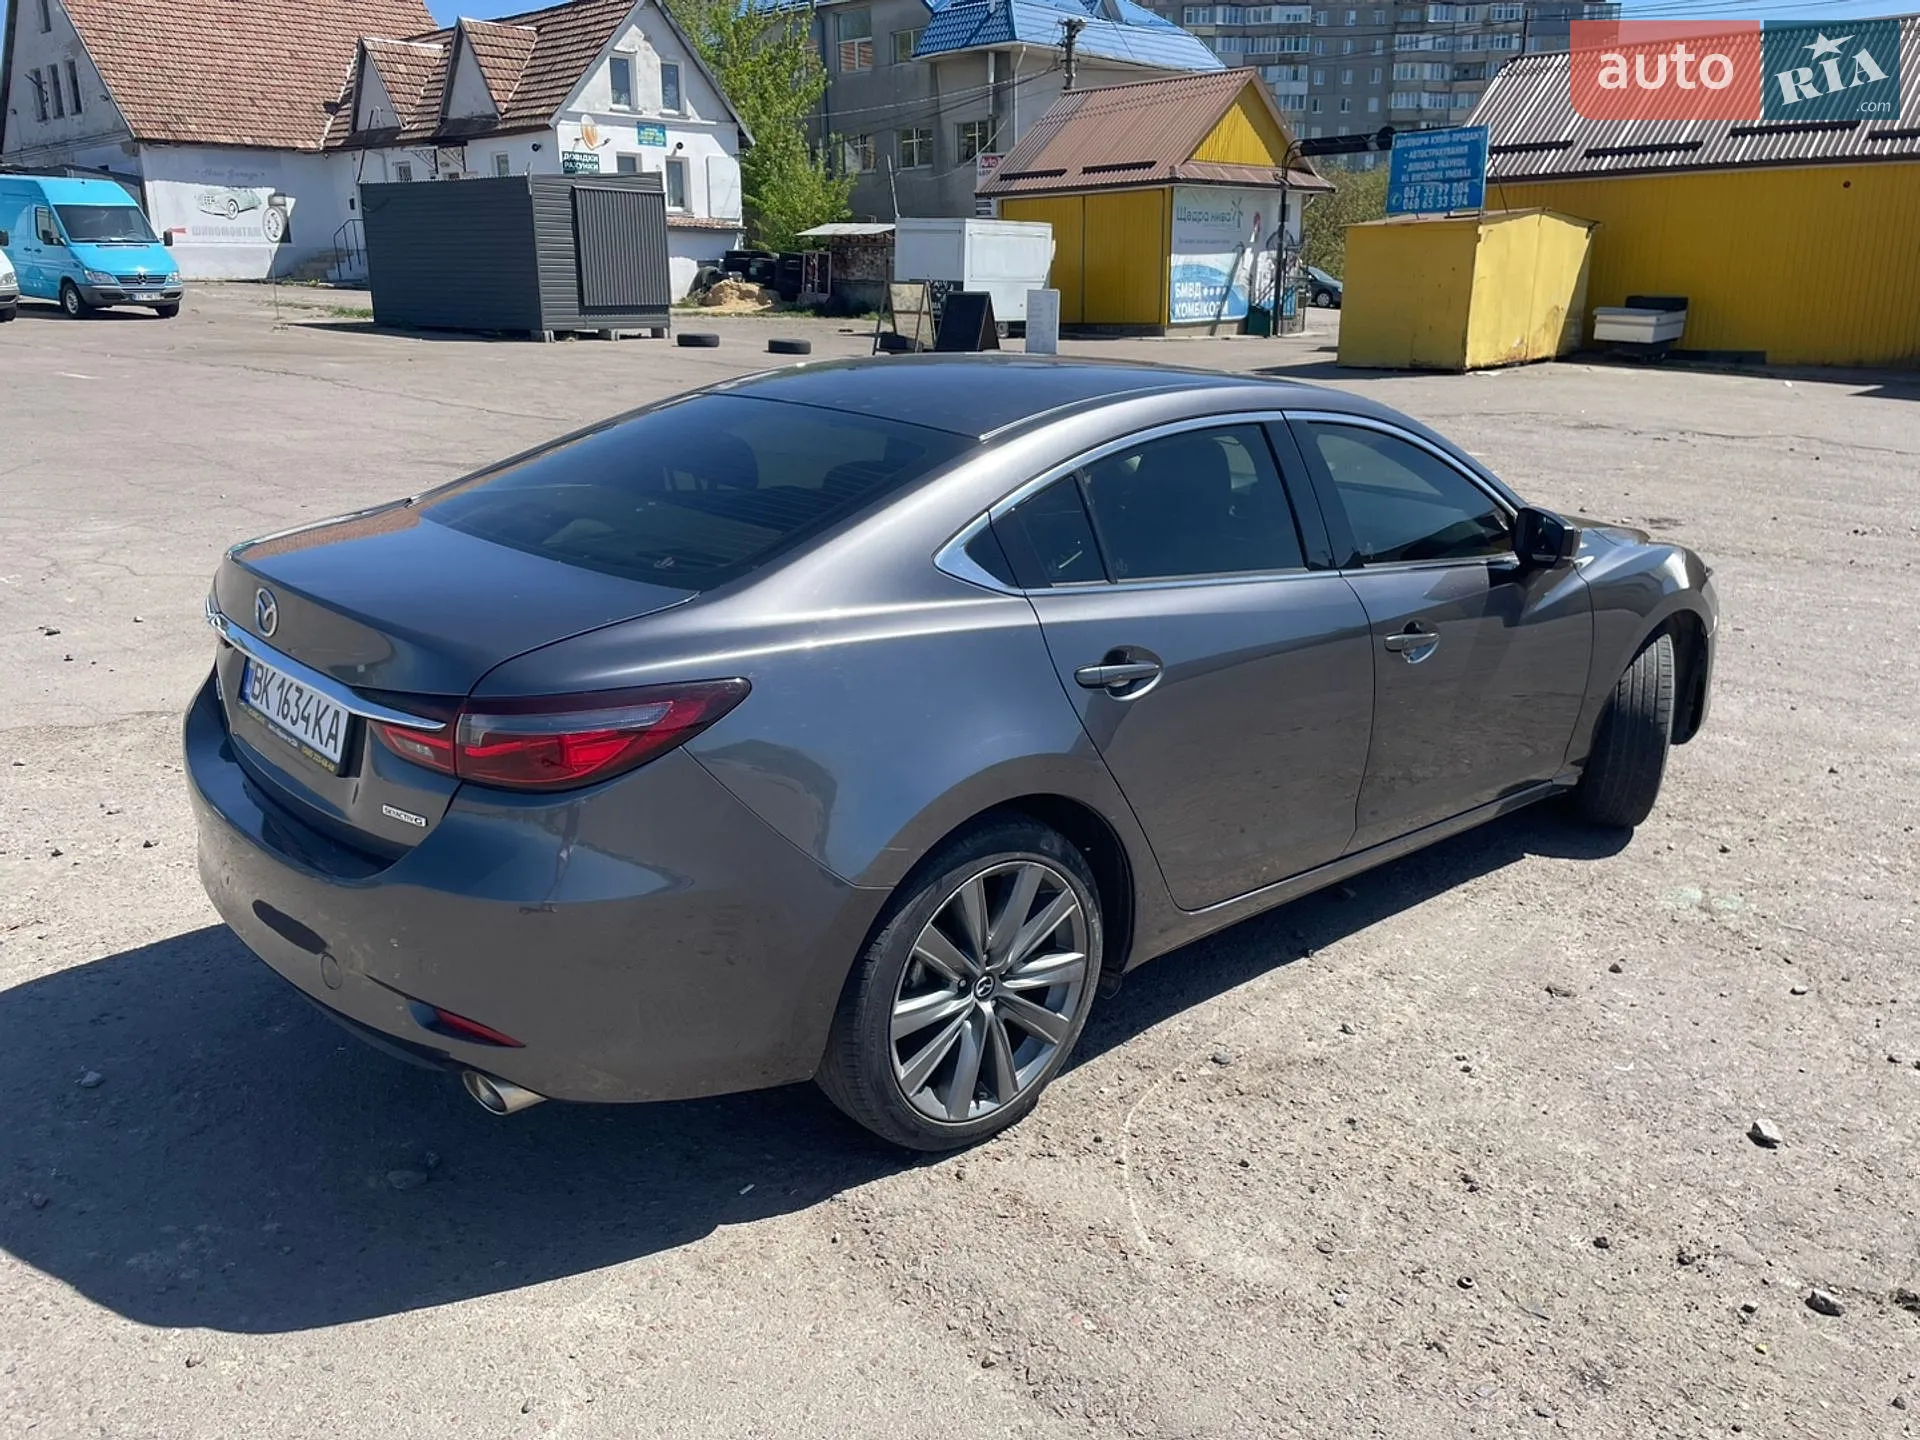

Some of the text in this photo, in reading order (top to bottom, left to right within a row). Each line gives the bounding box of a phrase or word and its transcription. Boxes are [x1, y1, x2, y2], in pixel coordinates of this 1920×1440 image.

[563, 153, 598, 162] ДОВІДКИ
[1176, 206, 1209, 225] Щедра
[1174, 282, 1201, 299] БМВД
